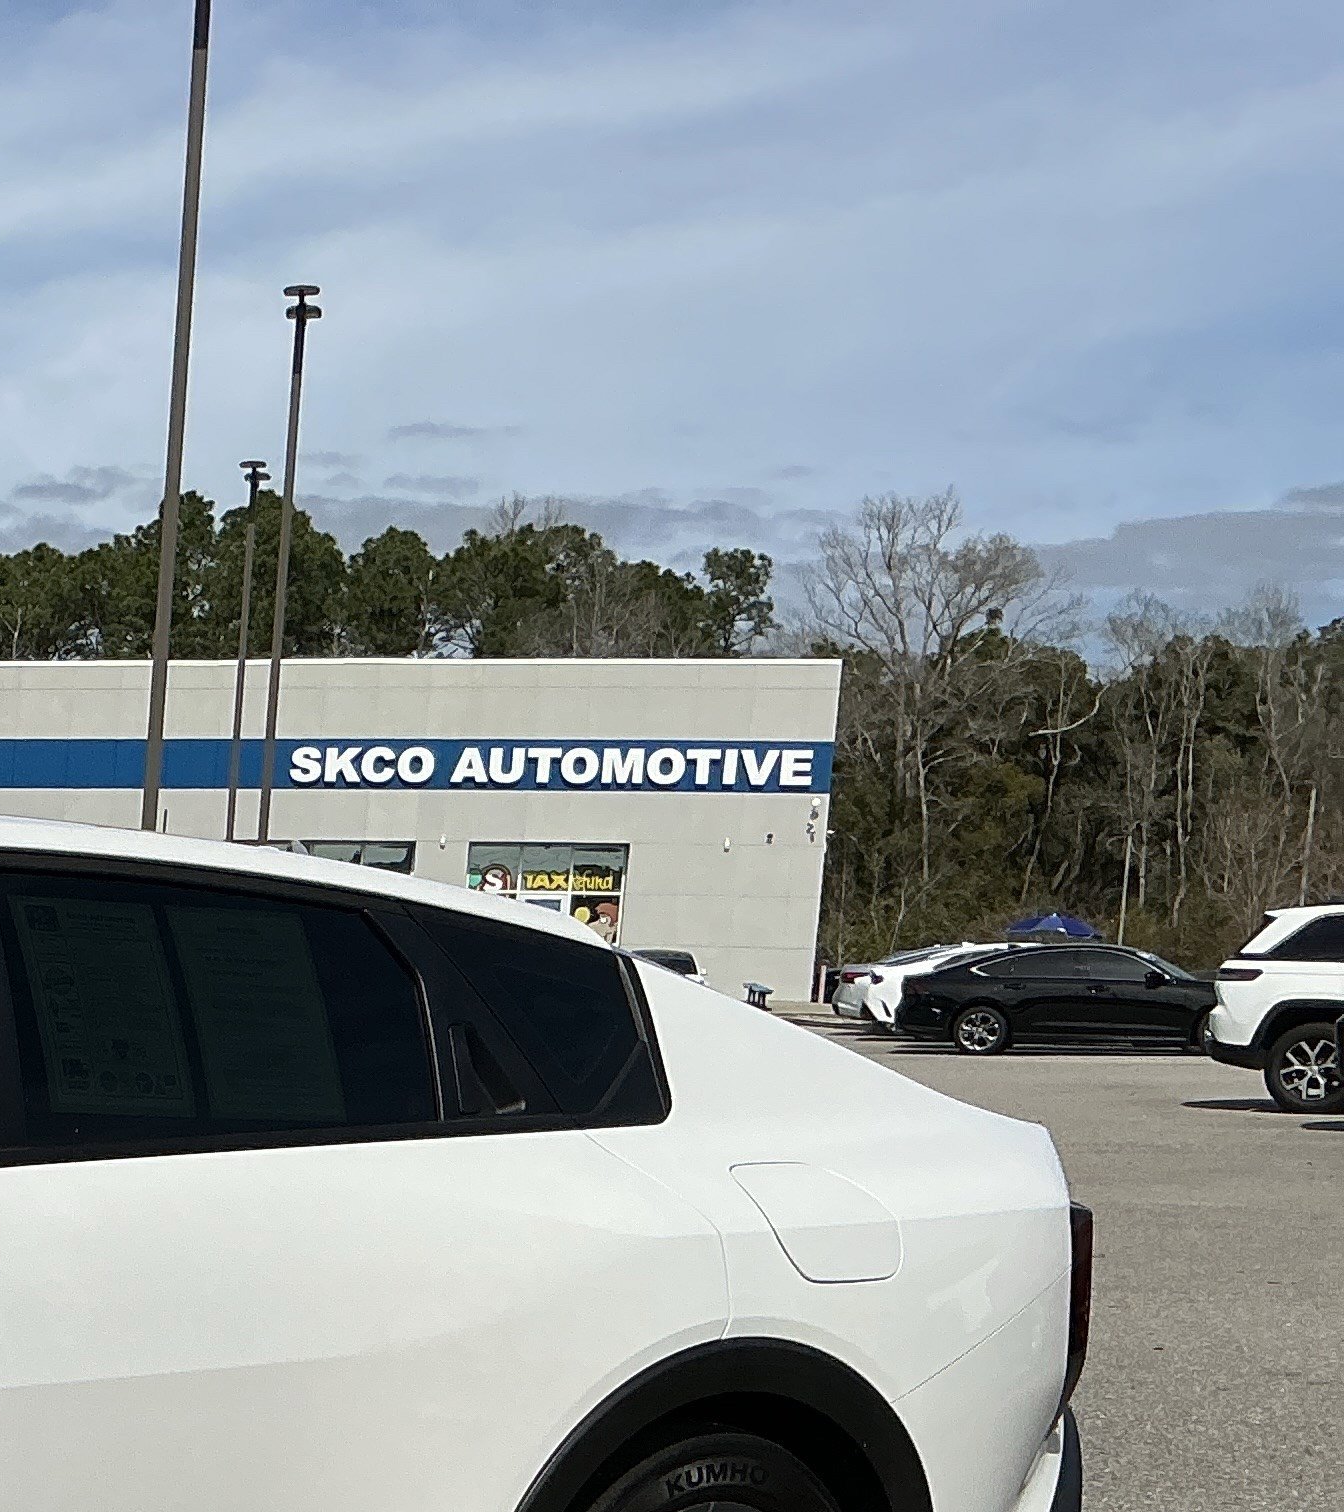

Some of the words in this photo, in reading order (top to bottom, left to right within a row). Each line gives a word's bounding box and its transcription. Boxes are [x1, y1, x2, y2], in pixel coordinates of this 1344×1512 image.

[288, 745, 437, 784] SKCO
[449, 746, 815, 787] AUTOMOTIVE
[523, 871, 569, 890] TAX
[665, 1462, 769, 1499] KUMHO
